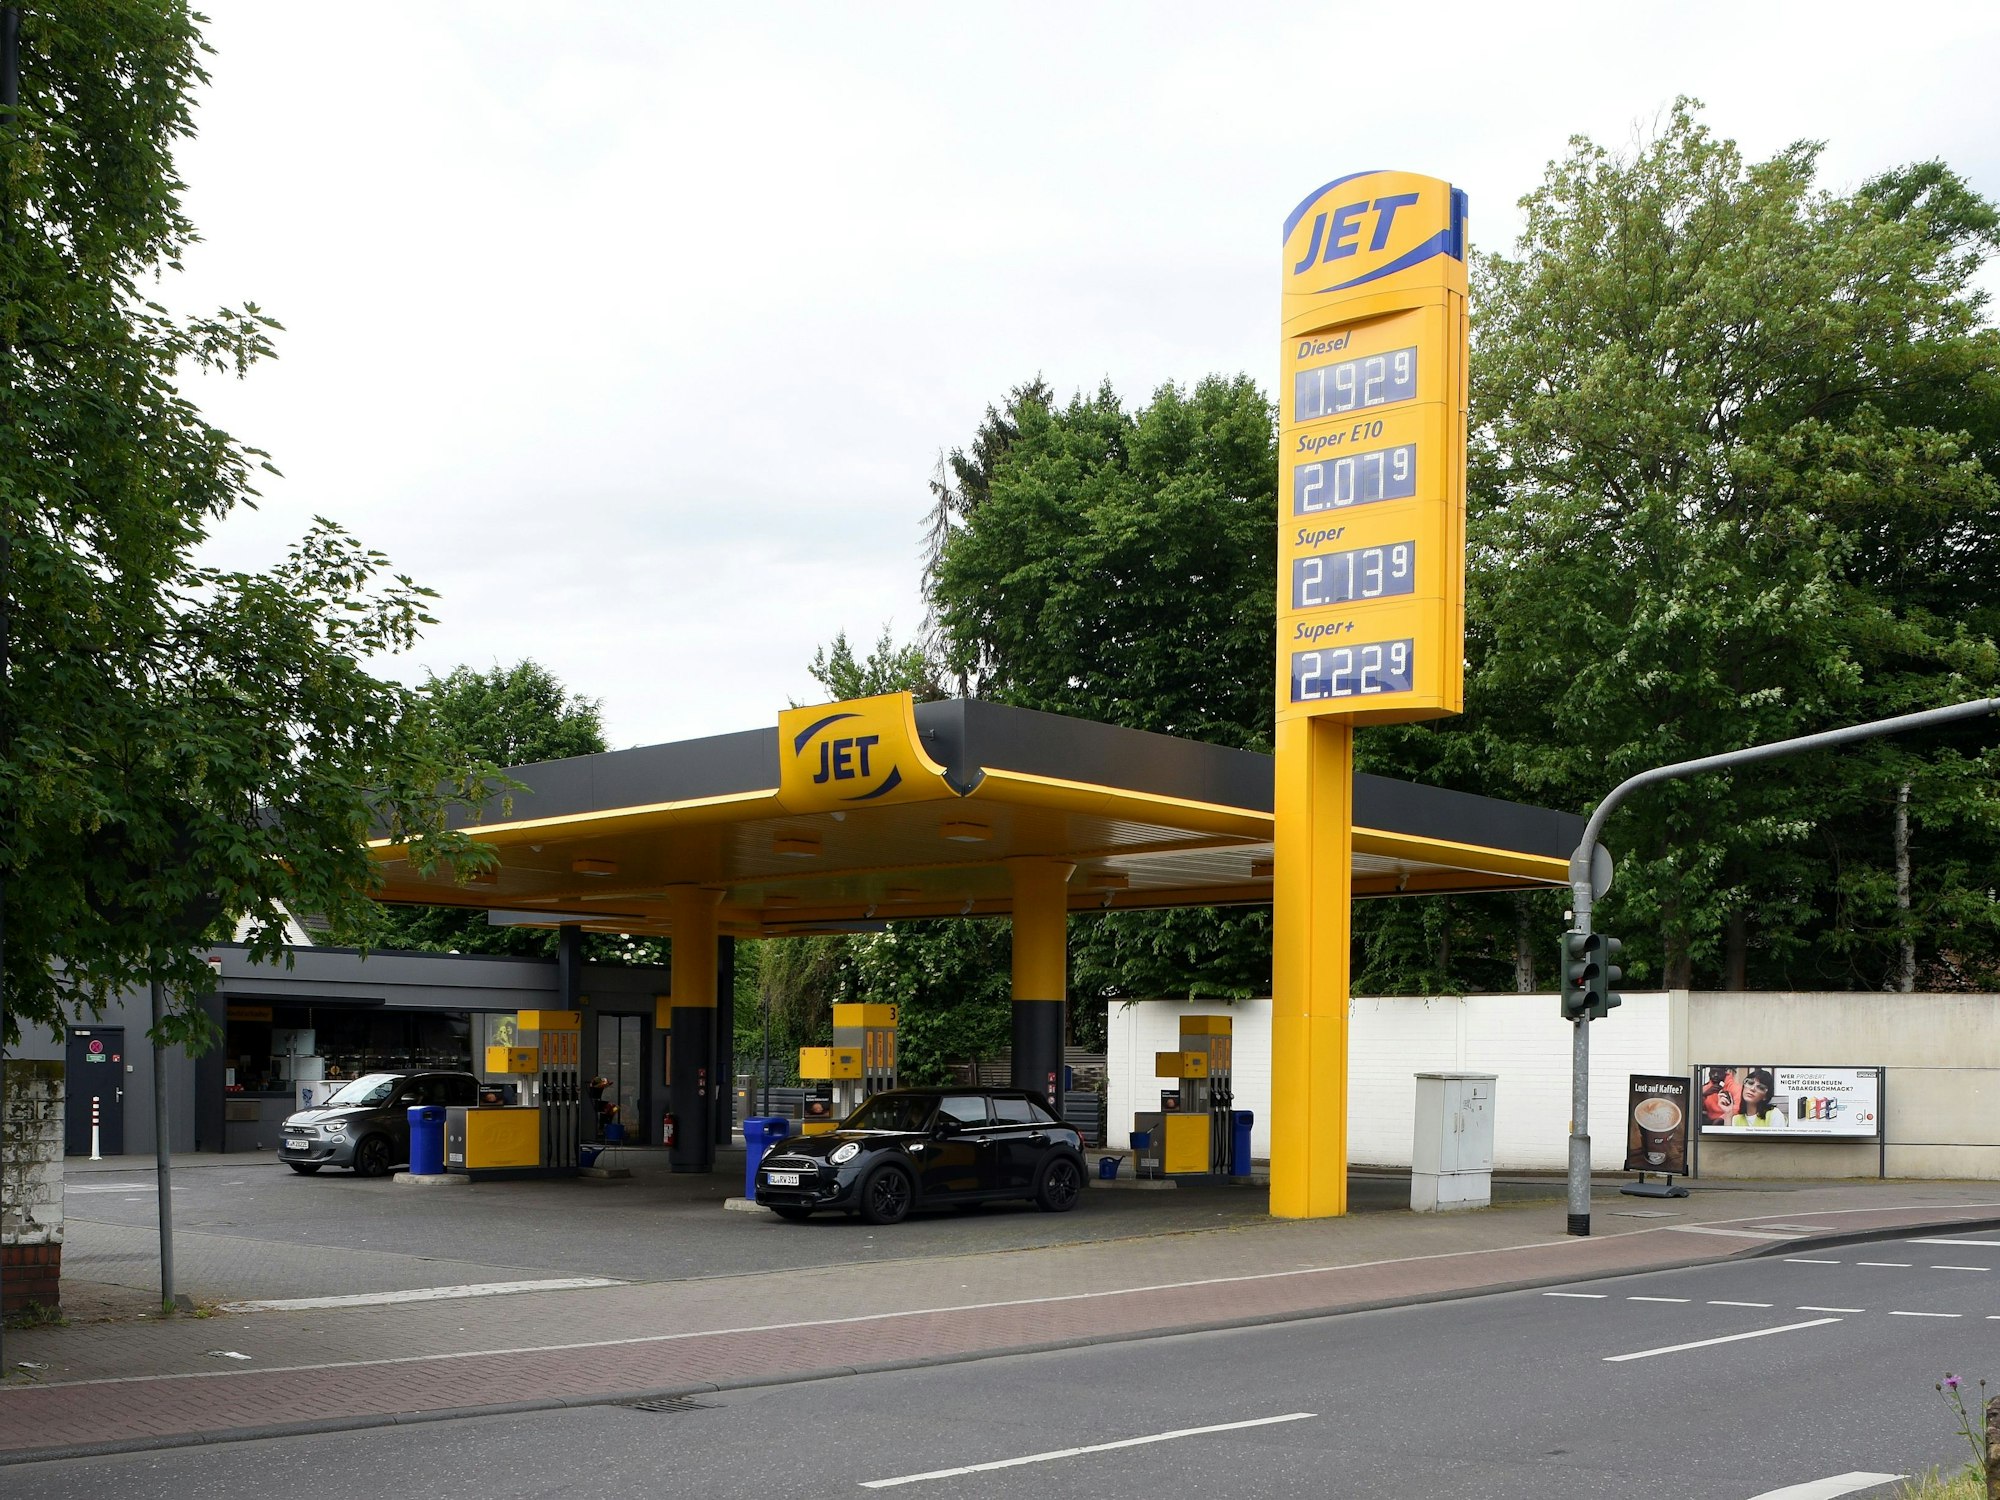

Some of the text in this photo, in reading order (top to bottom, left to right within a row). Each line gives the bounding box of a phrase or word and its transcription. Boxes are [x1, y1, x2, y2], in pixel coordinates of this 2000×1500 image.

[1294, 192, 1420, 275] JET
[1297, 330, 1351, 360] Diesel
[1296, 420, 1383, 455] Super E10
[1295, 524, 1345, 548] Super
[1294, 619, 1355, 643] Super+
[812, 735, 880, 784] JET
[573, 1013, 580, 1024] 7
[890, 1007, 896, 1020] 3
[1635, 1083, 1684, 1094] Lust auf Kaffee?
[1856, 1109, 1874, 1123] glo
